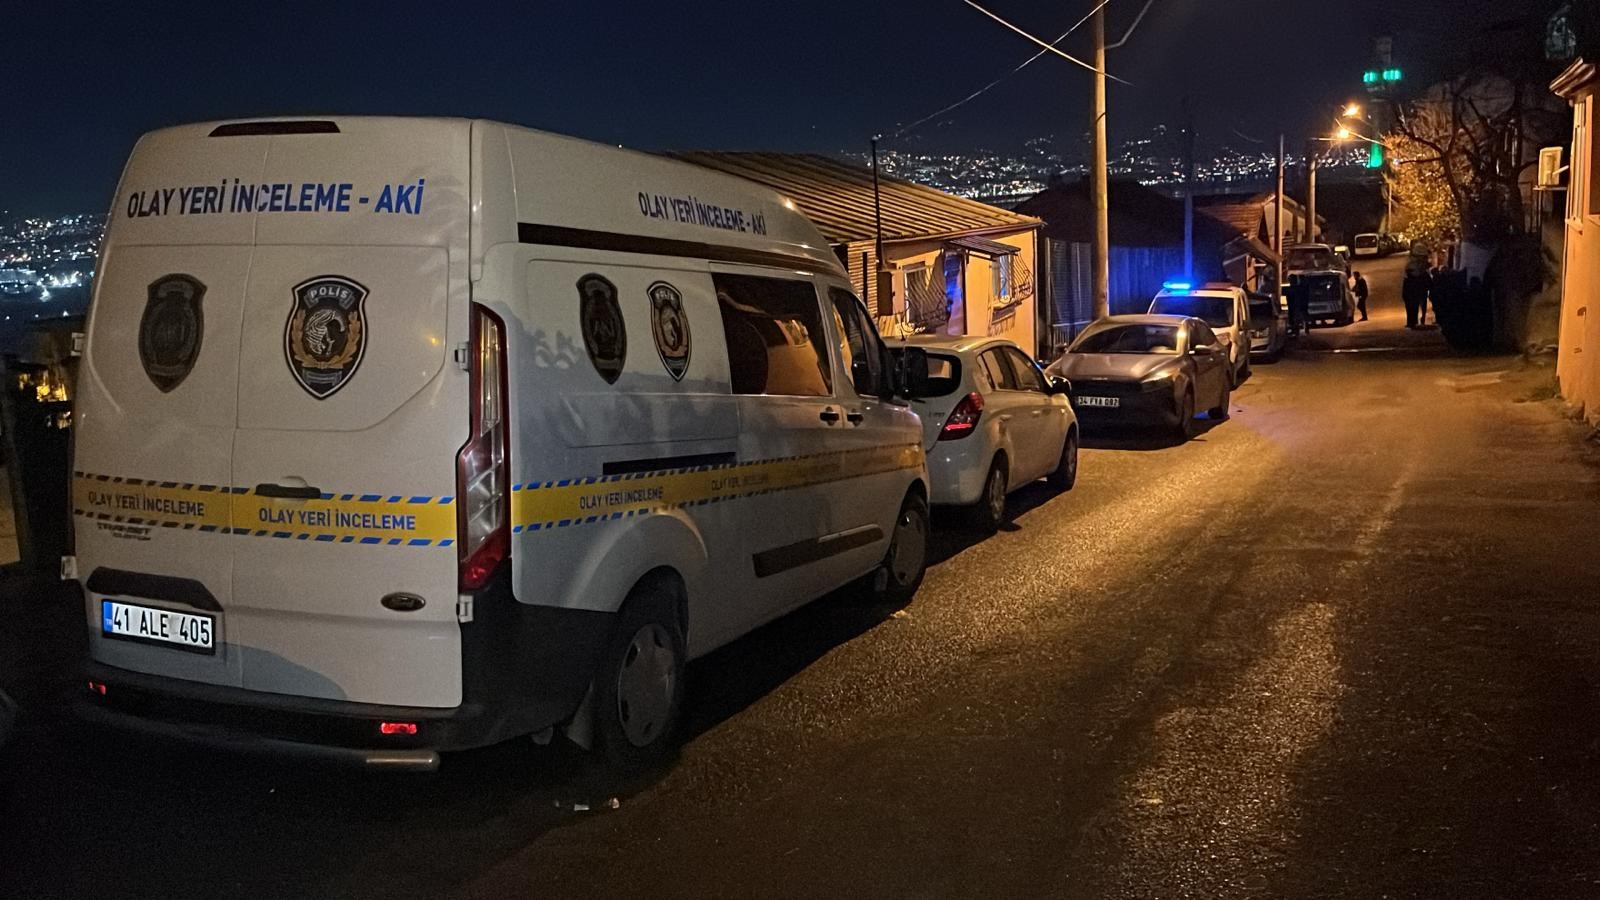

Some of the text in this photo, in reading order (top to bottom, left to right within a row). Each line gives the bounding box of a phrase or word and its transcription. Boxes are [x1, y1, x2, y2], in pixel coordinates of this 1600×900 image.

[127, 187, 175, 218] OLAY
[179, 179, 227, 215] YERİ
[230, 178, 353, 213] İNCELEME
[374, 178, 425, 215] AKİ
[638, 191, 669, 220] OLAY
[668, 195, 697, 225] YERİ
[694, 197, 746, 232] İNCELEME
[751, 211, 767, 236] AKİ
[88, 491, 205, 517] OLAY YERİ İNCELEME
[580, 494, 602, 509] OLAY
[259, 507, 416, 531] OLAY YERİ İNCELEME
[113, 606, 130, 632] 41
[139, 609, 169, 638] ALE
[179, 616, 210, 645] 405
